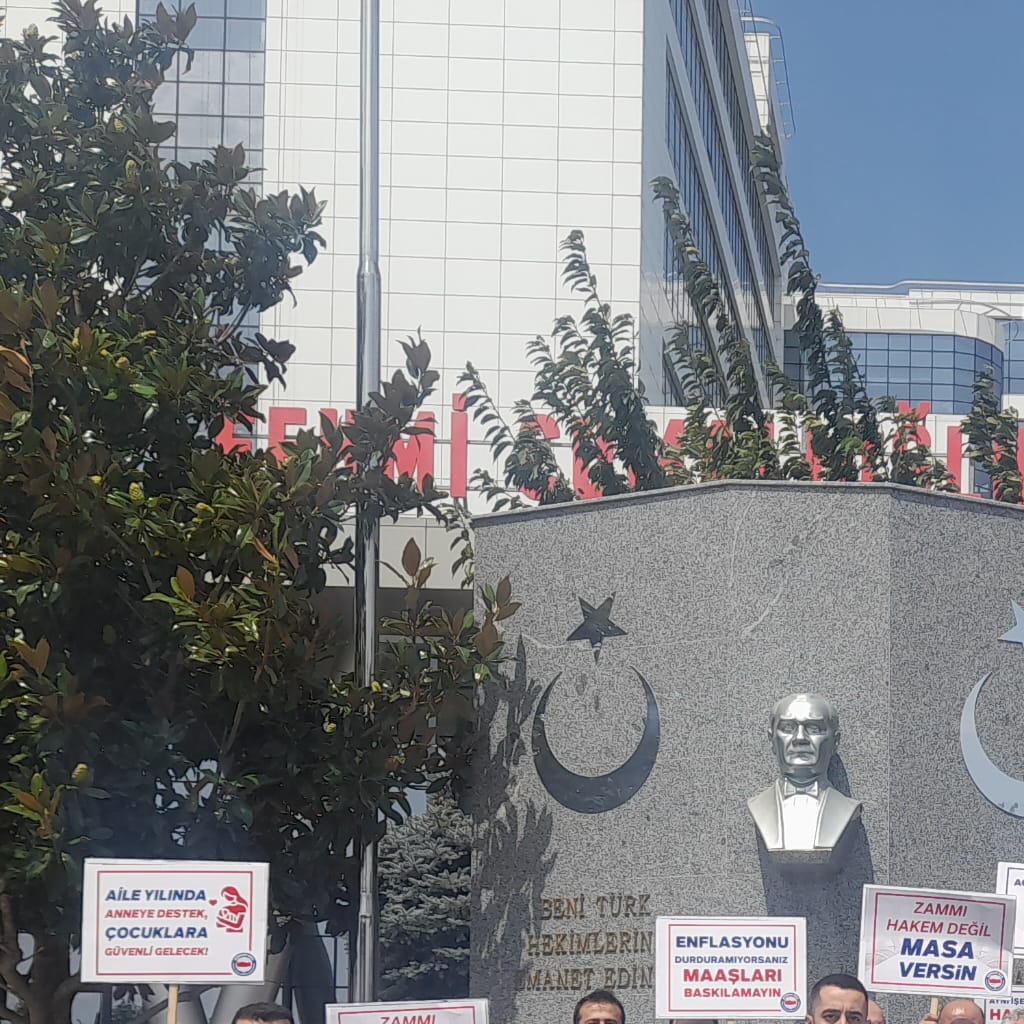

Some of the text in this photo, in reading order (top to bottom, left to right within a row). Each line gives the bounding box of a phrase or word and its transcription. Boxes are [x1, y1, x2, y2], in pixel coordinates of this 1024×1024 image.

[105, 887, 207, 901] AİLE YILINDA
[596, 893, 651, 917] TÜRK
[913, 902, 967, 917] ZAMMI
[105, 909, 208, 920] ANNEYE DESTEK,
[105, 927, 208, 941] ÇOCUKLARA
[886, 919, 992, 937] HAKEM DEĞİL
[527, 929, 653, 956] HEKİMLERİN
[675, 936, 789, 949] ENFLASYONU
[900, 938, 975, 959] MASA
[105, 946, 208, 956] GÜVENLİ GELECEK!
[674, 956, 789, 964] DURDURAMIYORSANIZ
[604, 964, 653, 989] EDİN
[683, 969, 782, 985] MAAŞLARI
[684, 988, 781, 998] BASKILAMAYIN
